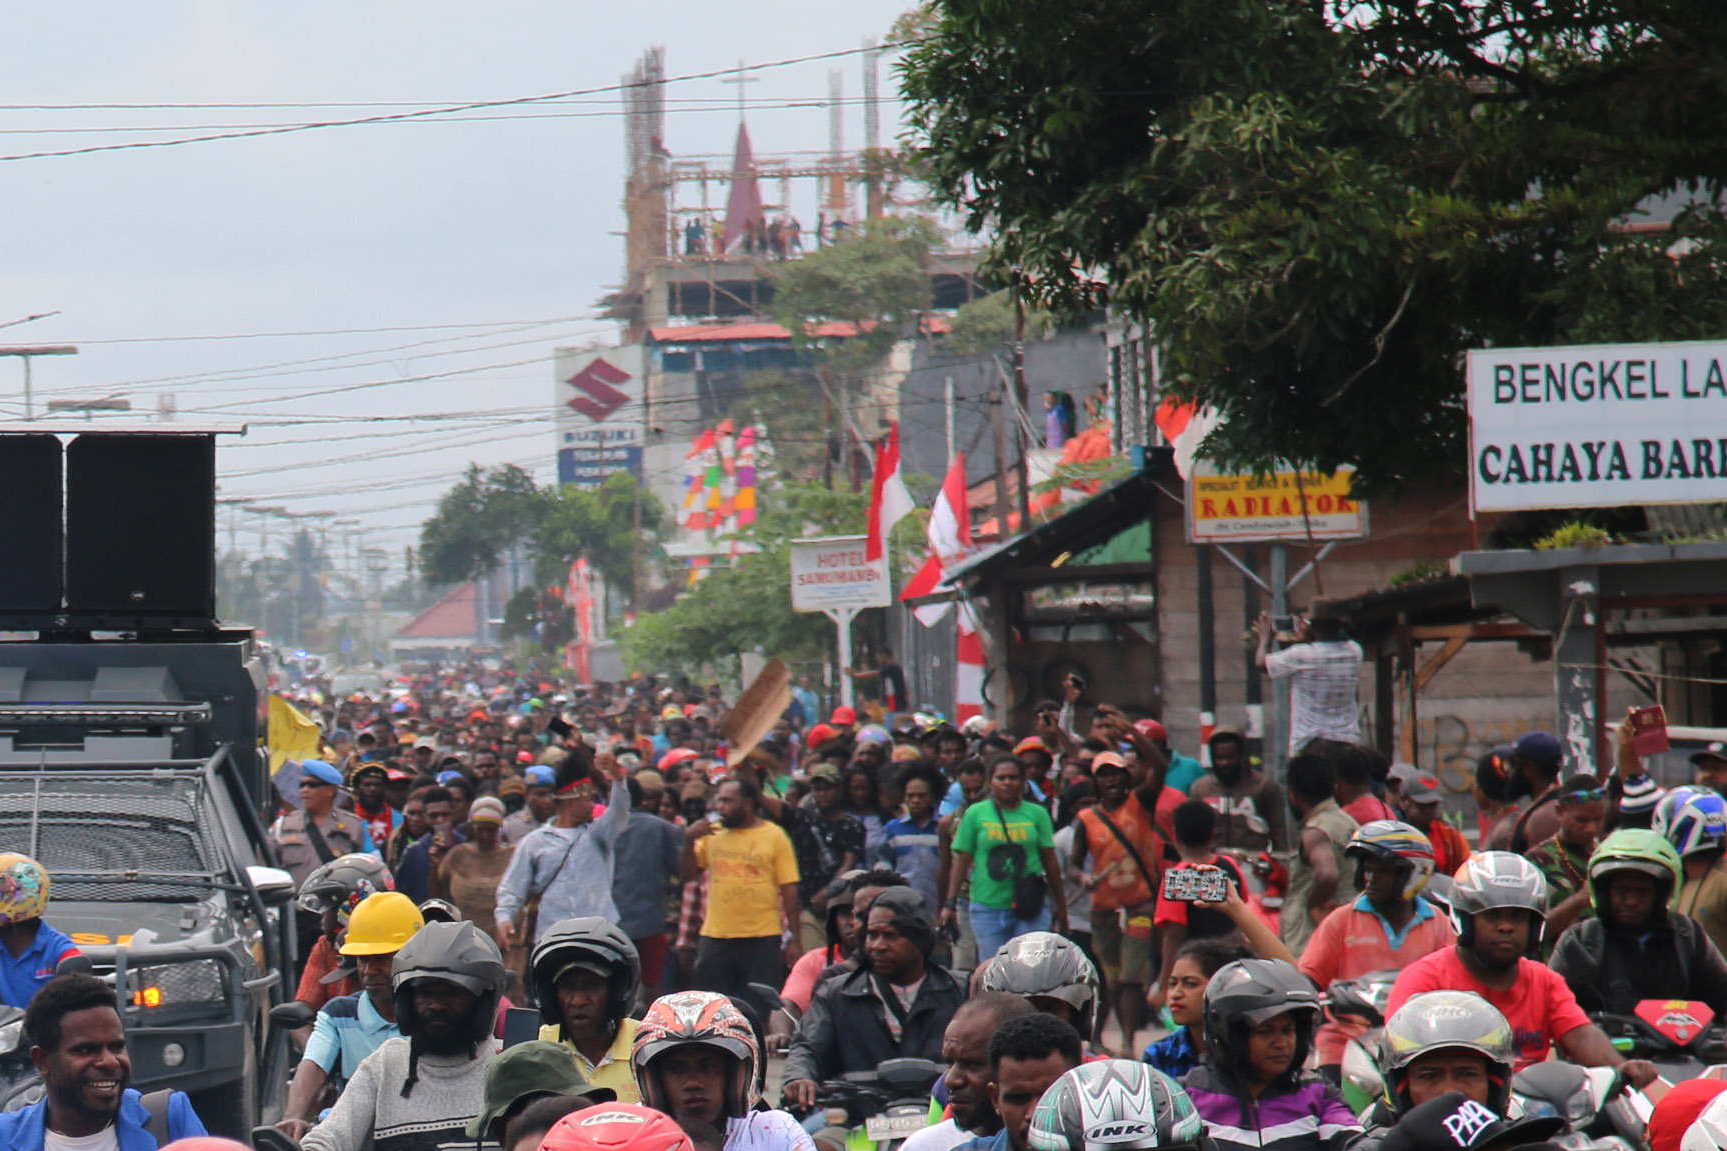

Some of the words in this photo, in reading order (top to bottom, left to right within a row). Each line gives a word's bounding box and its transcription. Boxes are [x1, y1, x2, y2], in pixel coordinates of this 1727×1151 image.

[1494, 361, 1670, 403] BENGKEL
[1479, 440, 1631, 484] CAHAYA
[1092, 1124, 1146, 1138] INK
